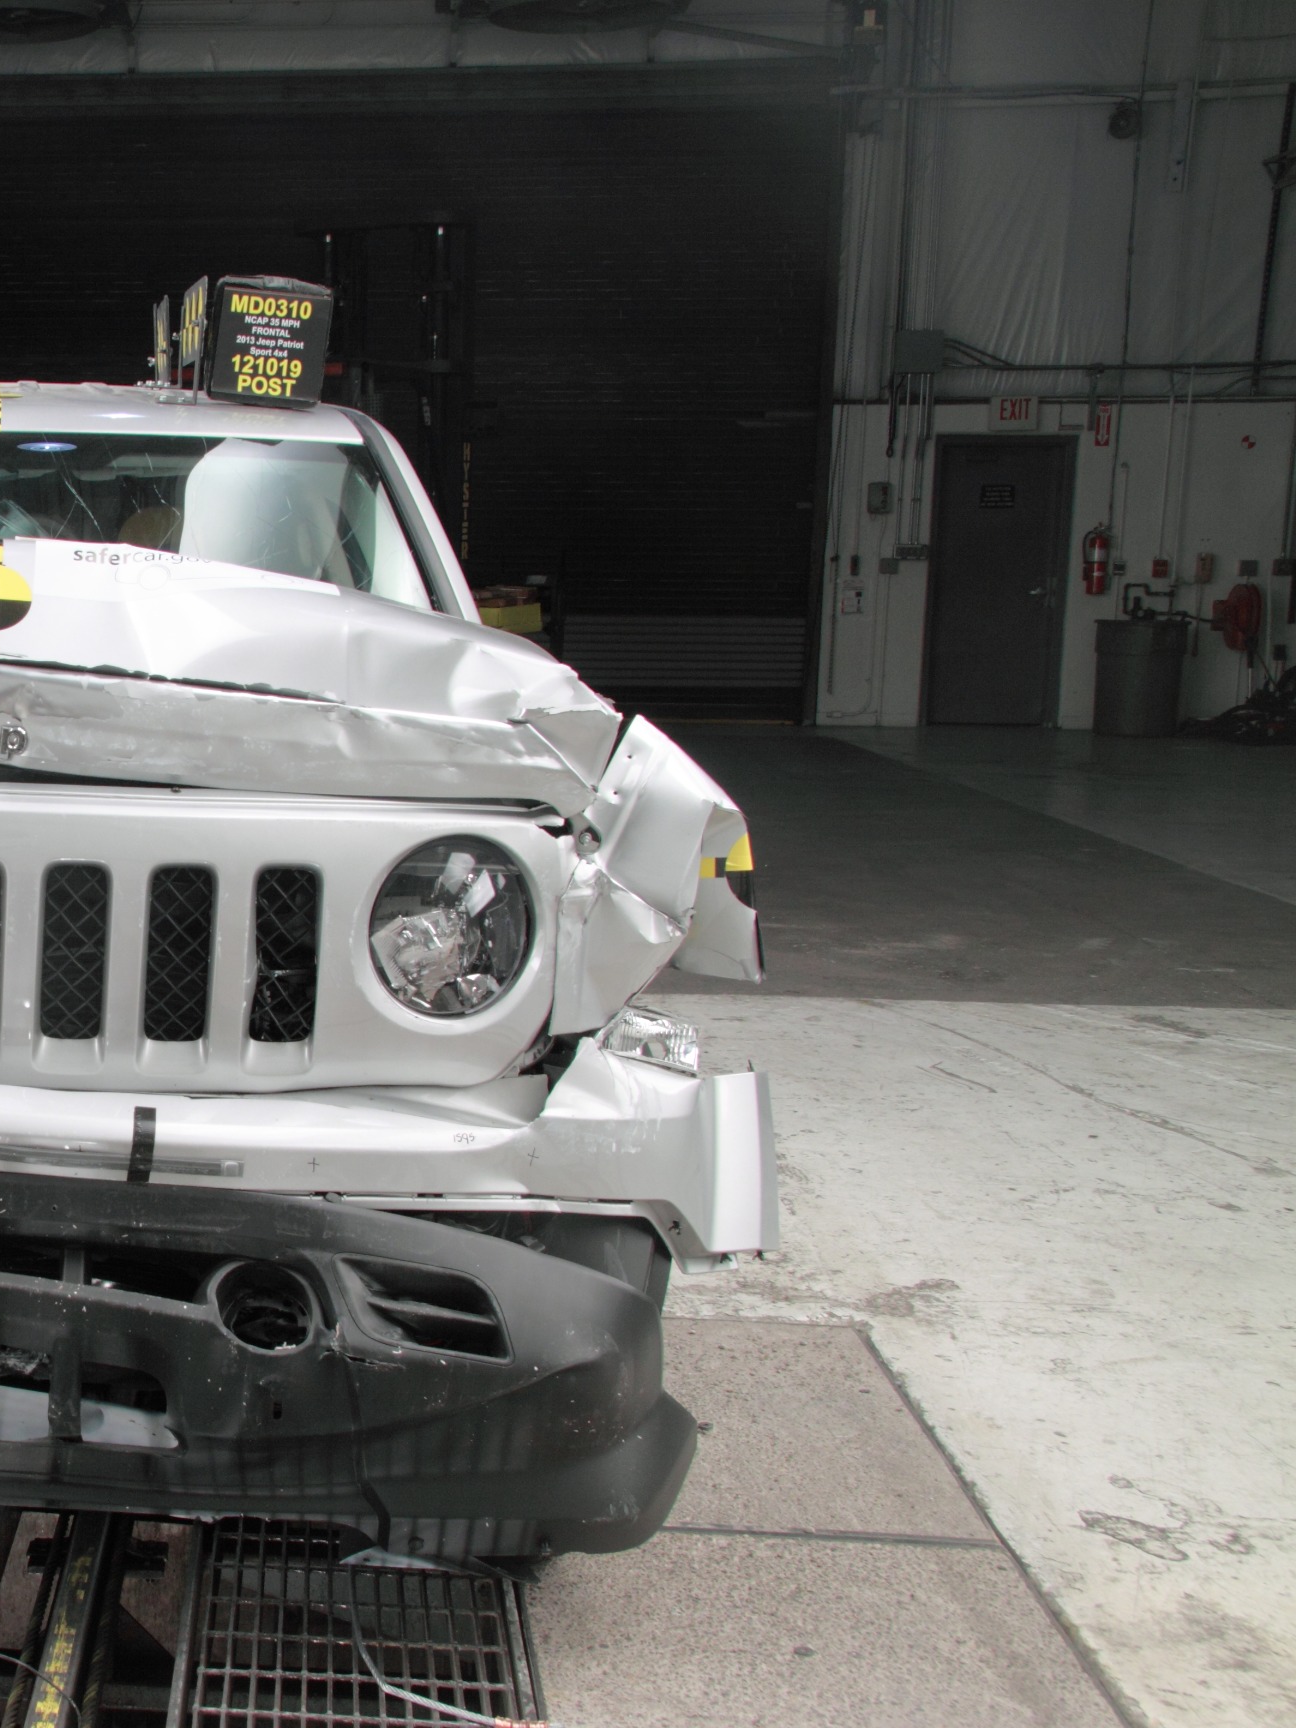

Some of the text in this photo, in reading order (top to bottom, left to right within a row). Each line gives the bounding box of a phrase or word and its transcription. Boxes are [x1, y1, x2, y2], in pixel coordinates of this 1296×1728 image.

[231, 294, 312, 319] MD0310
[244, 315, 300, 328] NCAP 35 MPH
[252, 326, 290, 337] FRONTAL
[236, 335, 304, 349] 2013 Jeep Patriot
[250, 347, 288, 358] Sport 4x4
[231, 354, 302, 378] 121019
[237, 374, 296, 397] POST
[1000, 398, 1031, 420] EXIT
